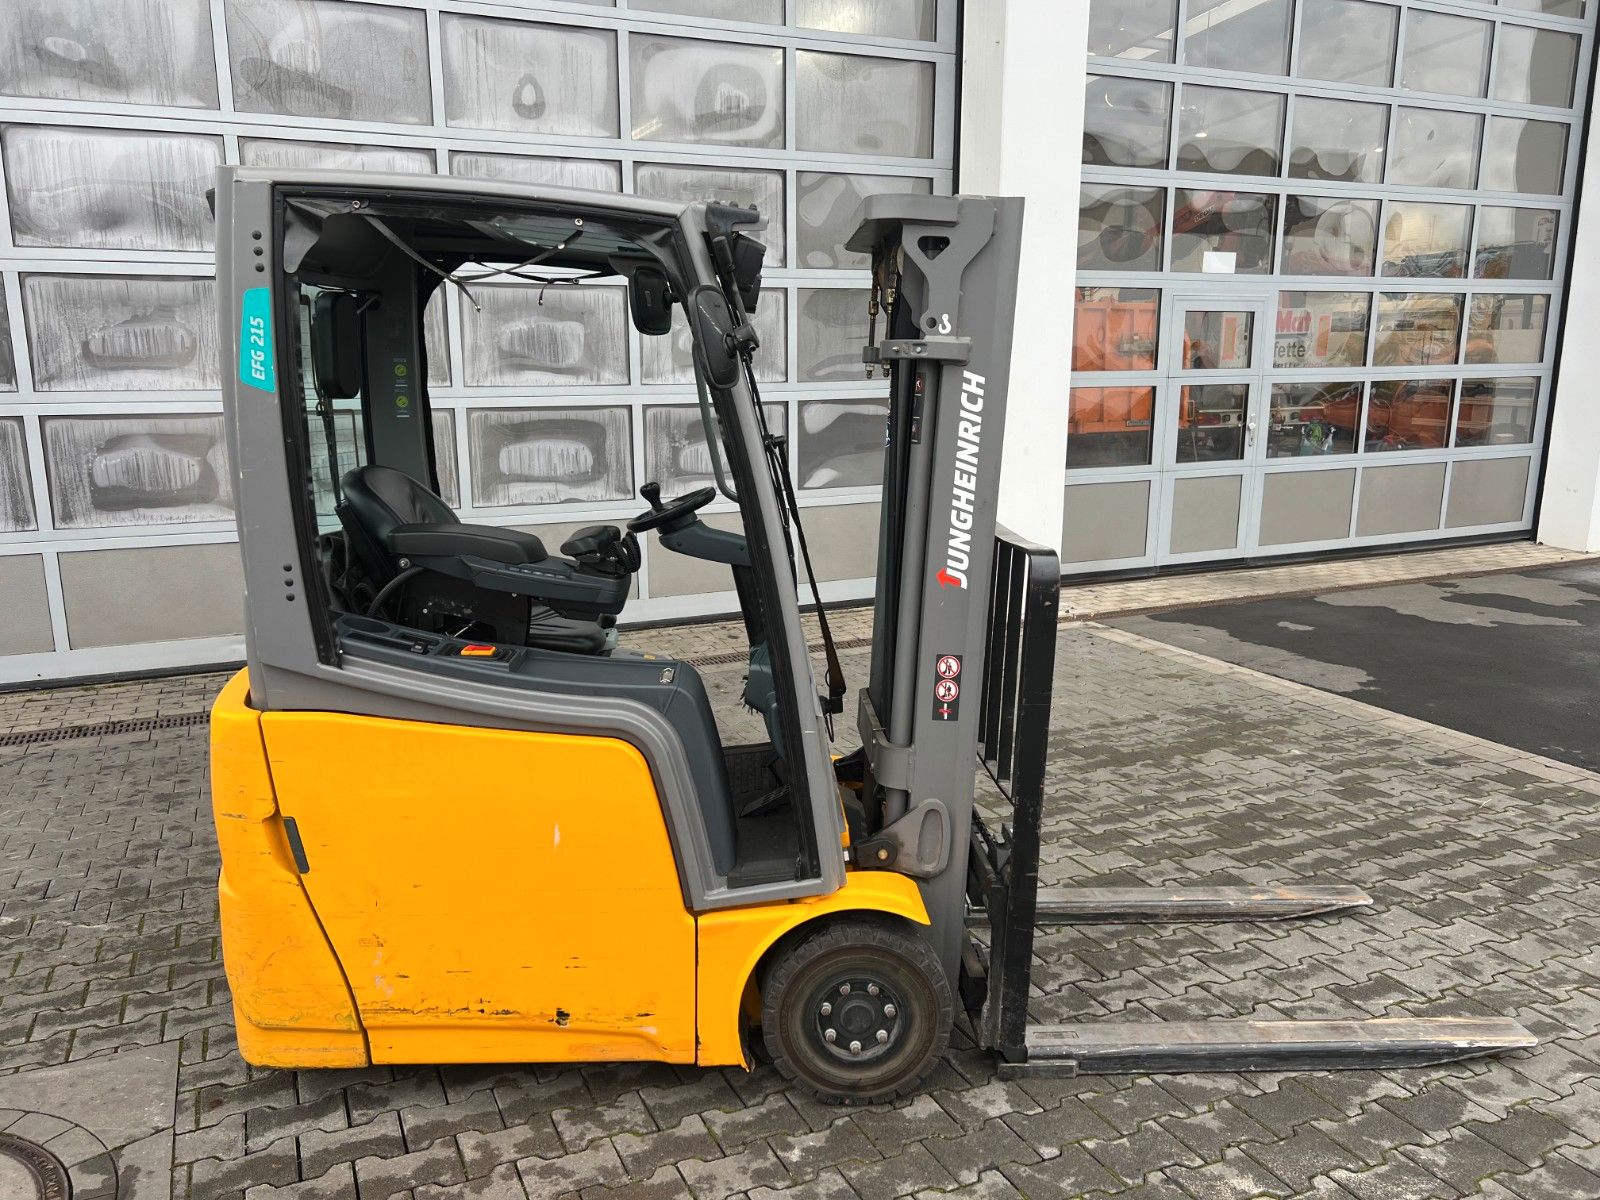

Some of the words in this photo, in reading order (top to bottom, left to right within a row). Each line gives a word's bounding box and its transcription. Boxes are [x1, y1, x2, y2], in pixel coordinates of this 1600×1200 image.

[249, 316, 264, 347] 215
[251, 349, 266, 381] EFG
[936, 370, 986, 590] JUNGHEINRICH
